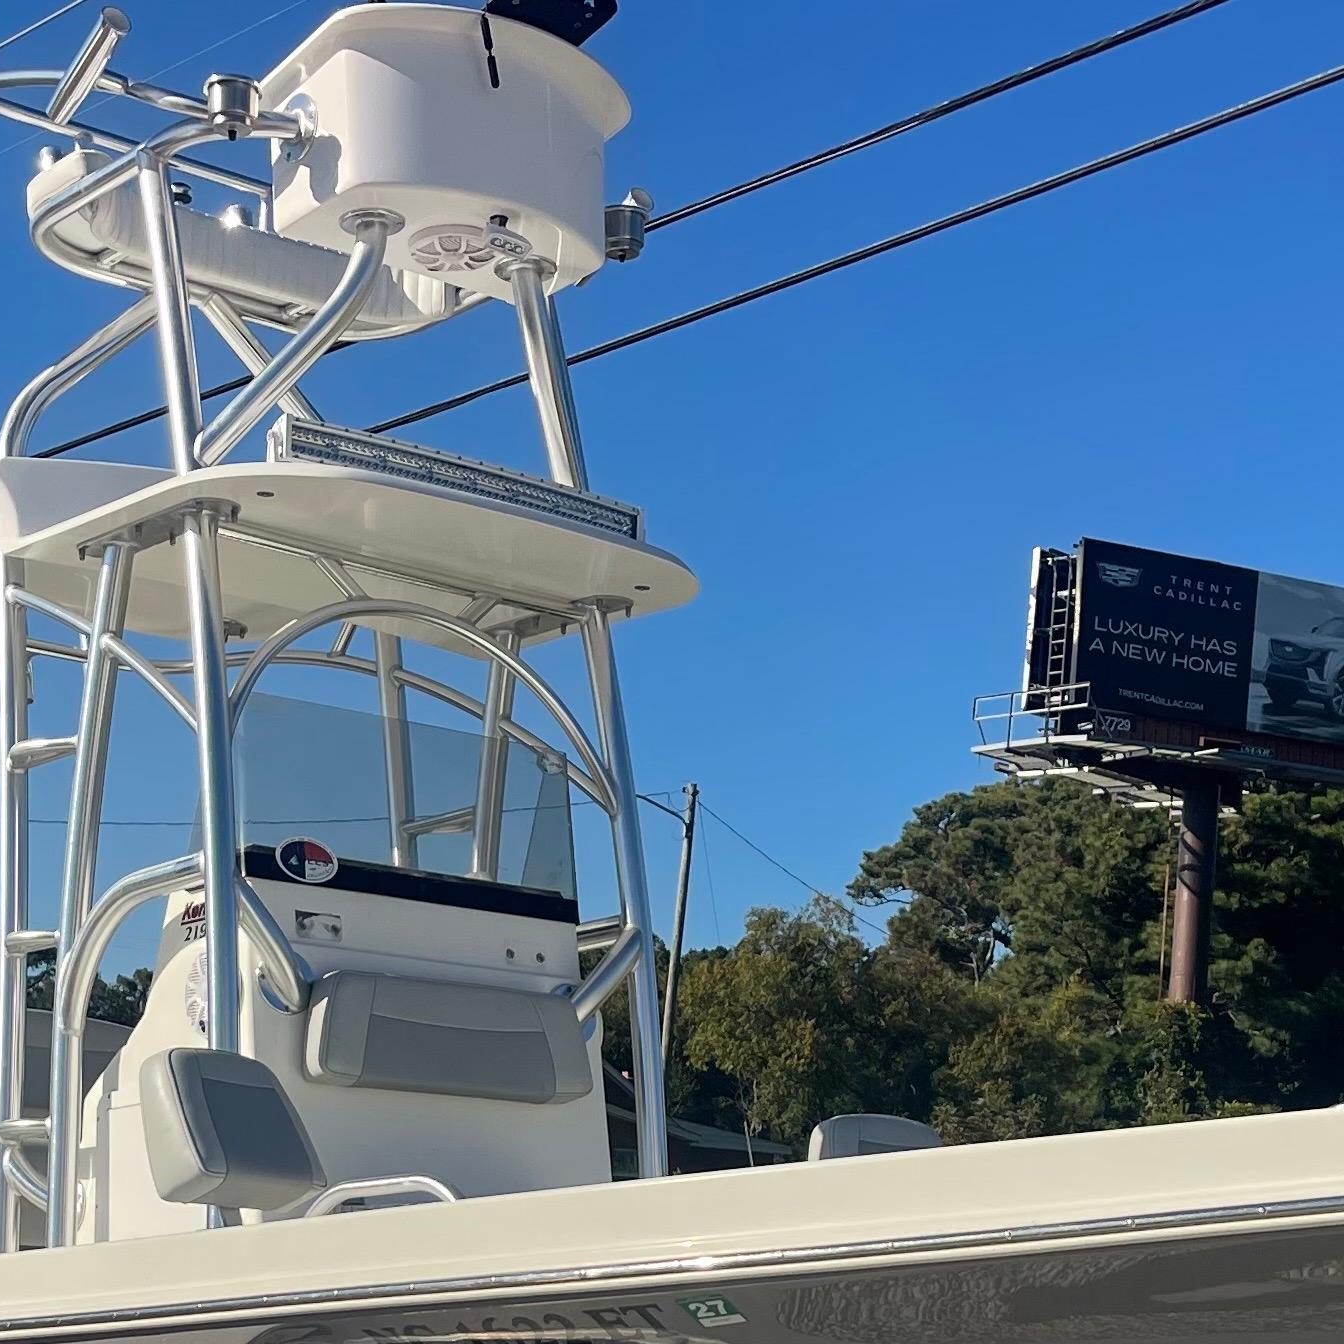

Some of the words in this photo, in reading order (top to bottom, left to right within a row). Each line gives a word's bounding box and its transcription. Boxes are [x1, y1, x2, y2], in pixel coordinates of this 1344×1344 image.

[1153, 585, 1242, 611] CADILLAC
[1169, 575, 1233, 596] TRENT
[1094, 615, 1185, 647] LUXURY
[1190, 634, 1238, 656] HAS
[1088, 637, 1105, 654] A
[1111, 640, 1166, 665] NEW
[1172, 653, 1238, 678] HOME
[688, 1299, 728, 1318] 27
